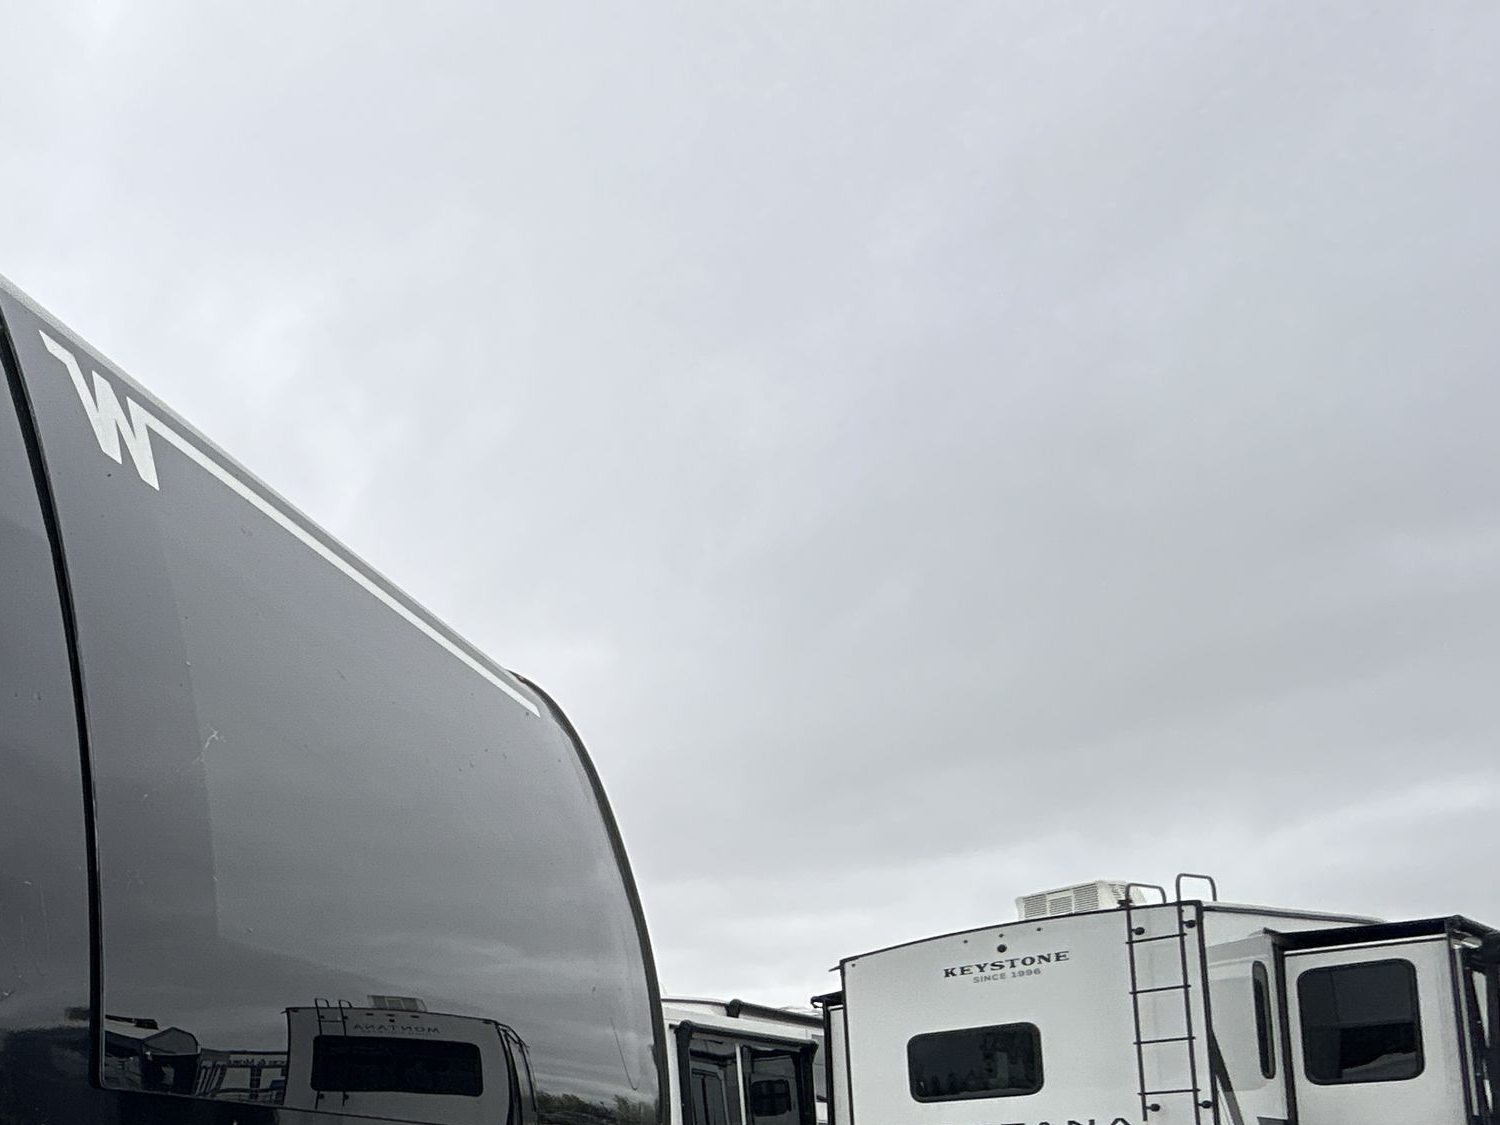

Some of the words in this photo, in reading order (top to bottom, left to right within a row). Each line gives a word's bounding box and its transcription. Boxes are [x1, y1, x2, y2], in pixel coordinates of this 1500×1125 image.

[943, 951, 1070, 978] KEYSTONE
[973, 973, 1007, 984] SINCE
[1011, 968, 1042, 979] 1996
